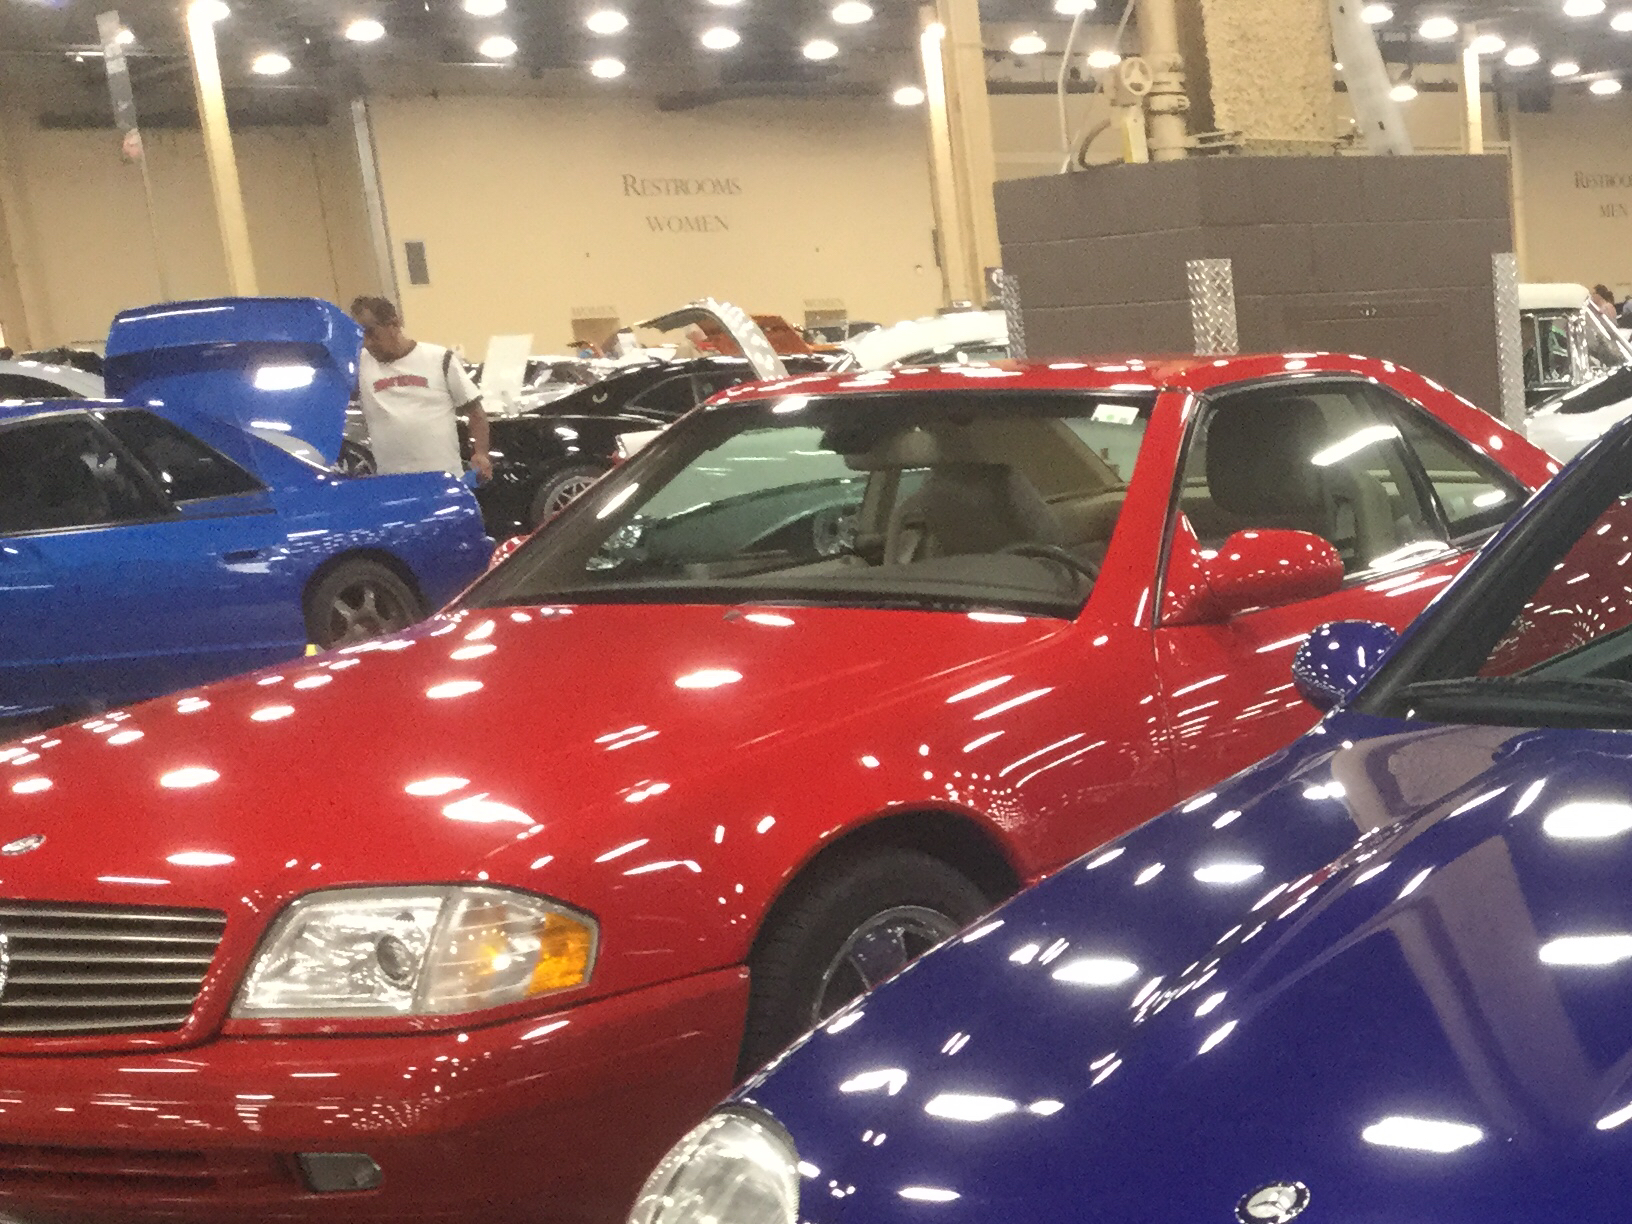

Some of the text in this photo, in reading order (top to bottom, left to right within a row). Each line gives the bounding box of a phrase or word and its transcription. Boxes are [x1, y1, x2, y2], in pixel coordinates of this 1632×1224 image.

[622, 172, 743, 196] RESTROOMS
[1600, 203, 1628, 218] MEN
[645, 214, 729, 233] WOMEN
